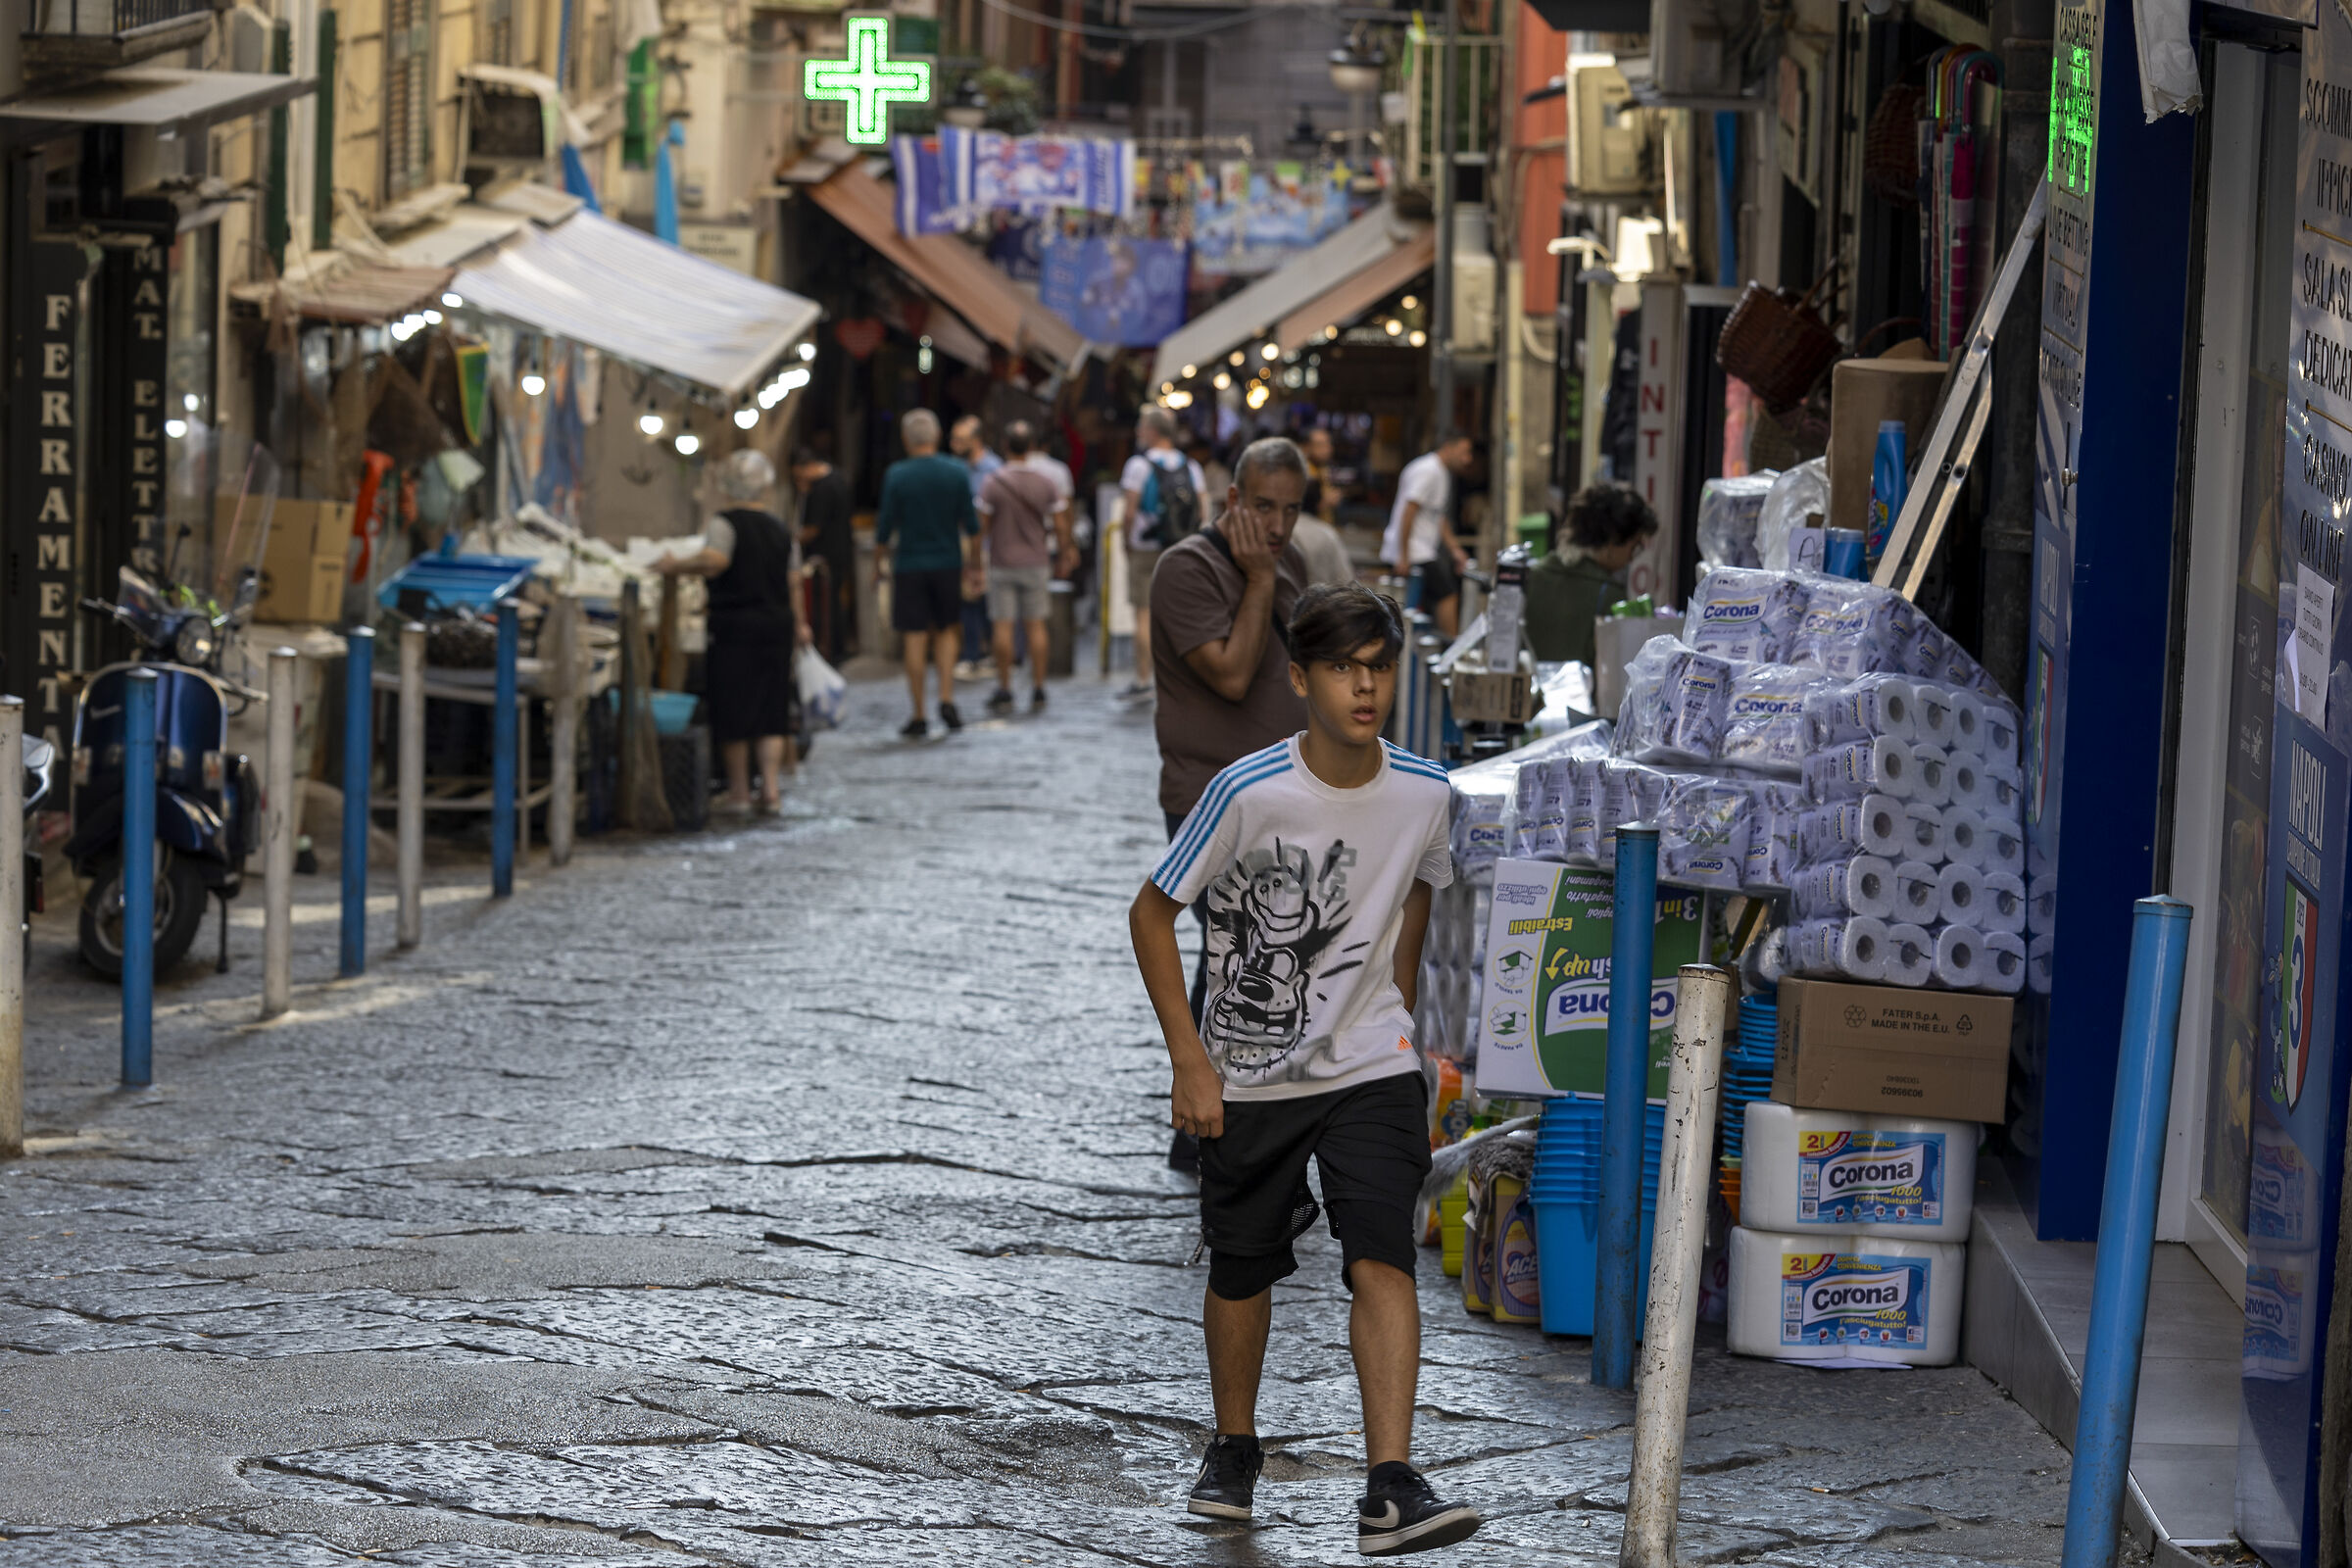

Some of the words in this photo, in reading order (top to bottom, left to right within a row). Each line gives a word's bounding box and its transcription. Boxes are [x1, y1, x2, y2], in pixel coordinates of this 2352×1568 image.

[2305, 78, 2352, 139] SCOMM
[2303, 252, 2335, 316] SALA
[1640, 338, 1664, 592] INTIO
[37, 295, 73, 761] FERRAMENTA
[1703, 604, 1760, 619] Corona
[1682, 678, 1716, 690] Corona
[1735, 698, 1802, 713] Corona
[1851, 692, 1861, 727] Corona
[1845, 747, 1855, 782] Corona
[2289, 739, 2327, 853] NAPOLI
[1835, 806, 1843, 841] Corona
[1689, 860, 1724, 872] Corona
[1496, 891, 1511, 903] per
[1497, 884, 1527, 895] utilizzo
[1508, 916, 1573, 935] Estraibili
[1883, 1007, 1913, 1018] FATER
[1872, 1019, 1898, 1029] MADE
[1900, 1020, 1910, 1030] IN
[1912, 1021, 1932, 1032] THE
[1934, 1023, 1950, 1034] E.U.
[1807, 1135, 1819, 1149] 2
[1829, 1161, 1914, 1188] Corona
[1891, 1186, 1922, 1197] 1000
[1790, 1257, 1802, 1271] 2
[1812, 1286, 1898, 1310] Corona
[1876, 1309, 1907, 1320] 1000
